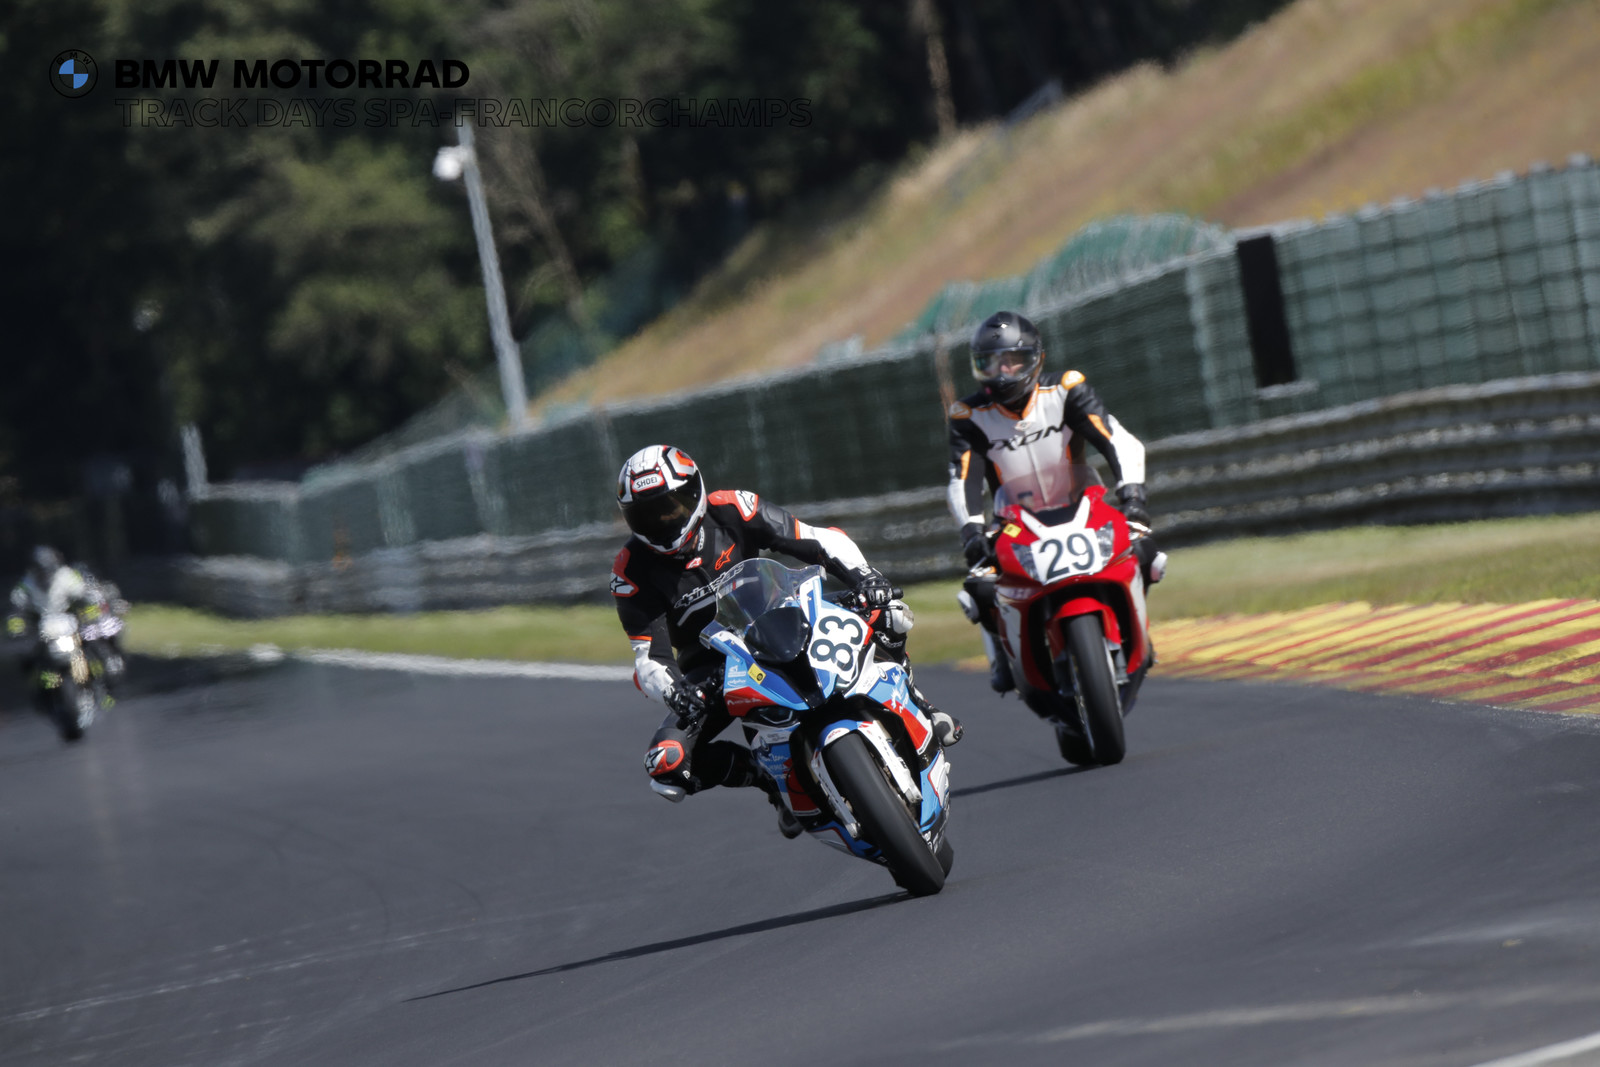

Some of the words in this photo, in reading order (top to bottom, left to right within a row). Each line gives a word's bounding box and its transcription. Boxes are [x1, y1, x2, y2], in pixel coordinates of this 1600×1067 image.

[636, 476, 658, 489] SHOEI
[1038, 533, 1096, 579] 29
[810, 615, 863, 672] 83
